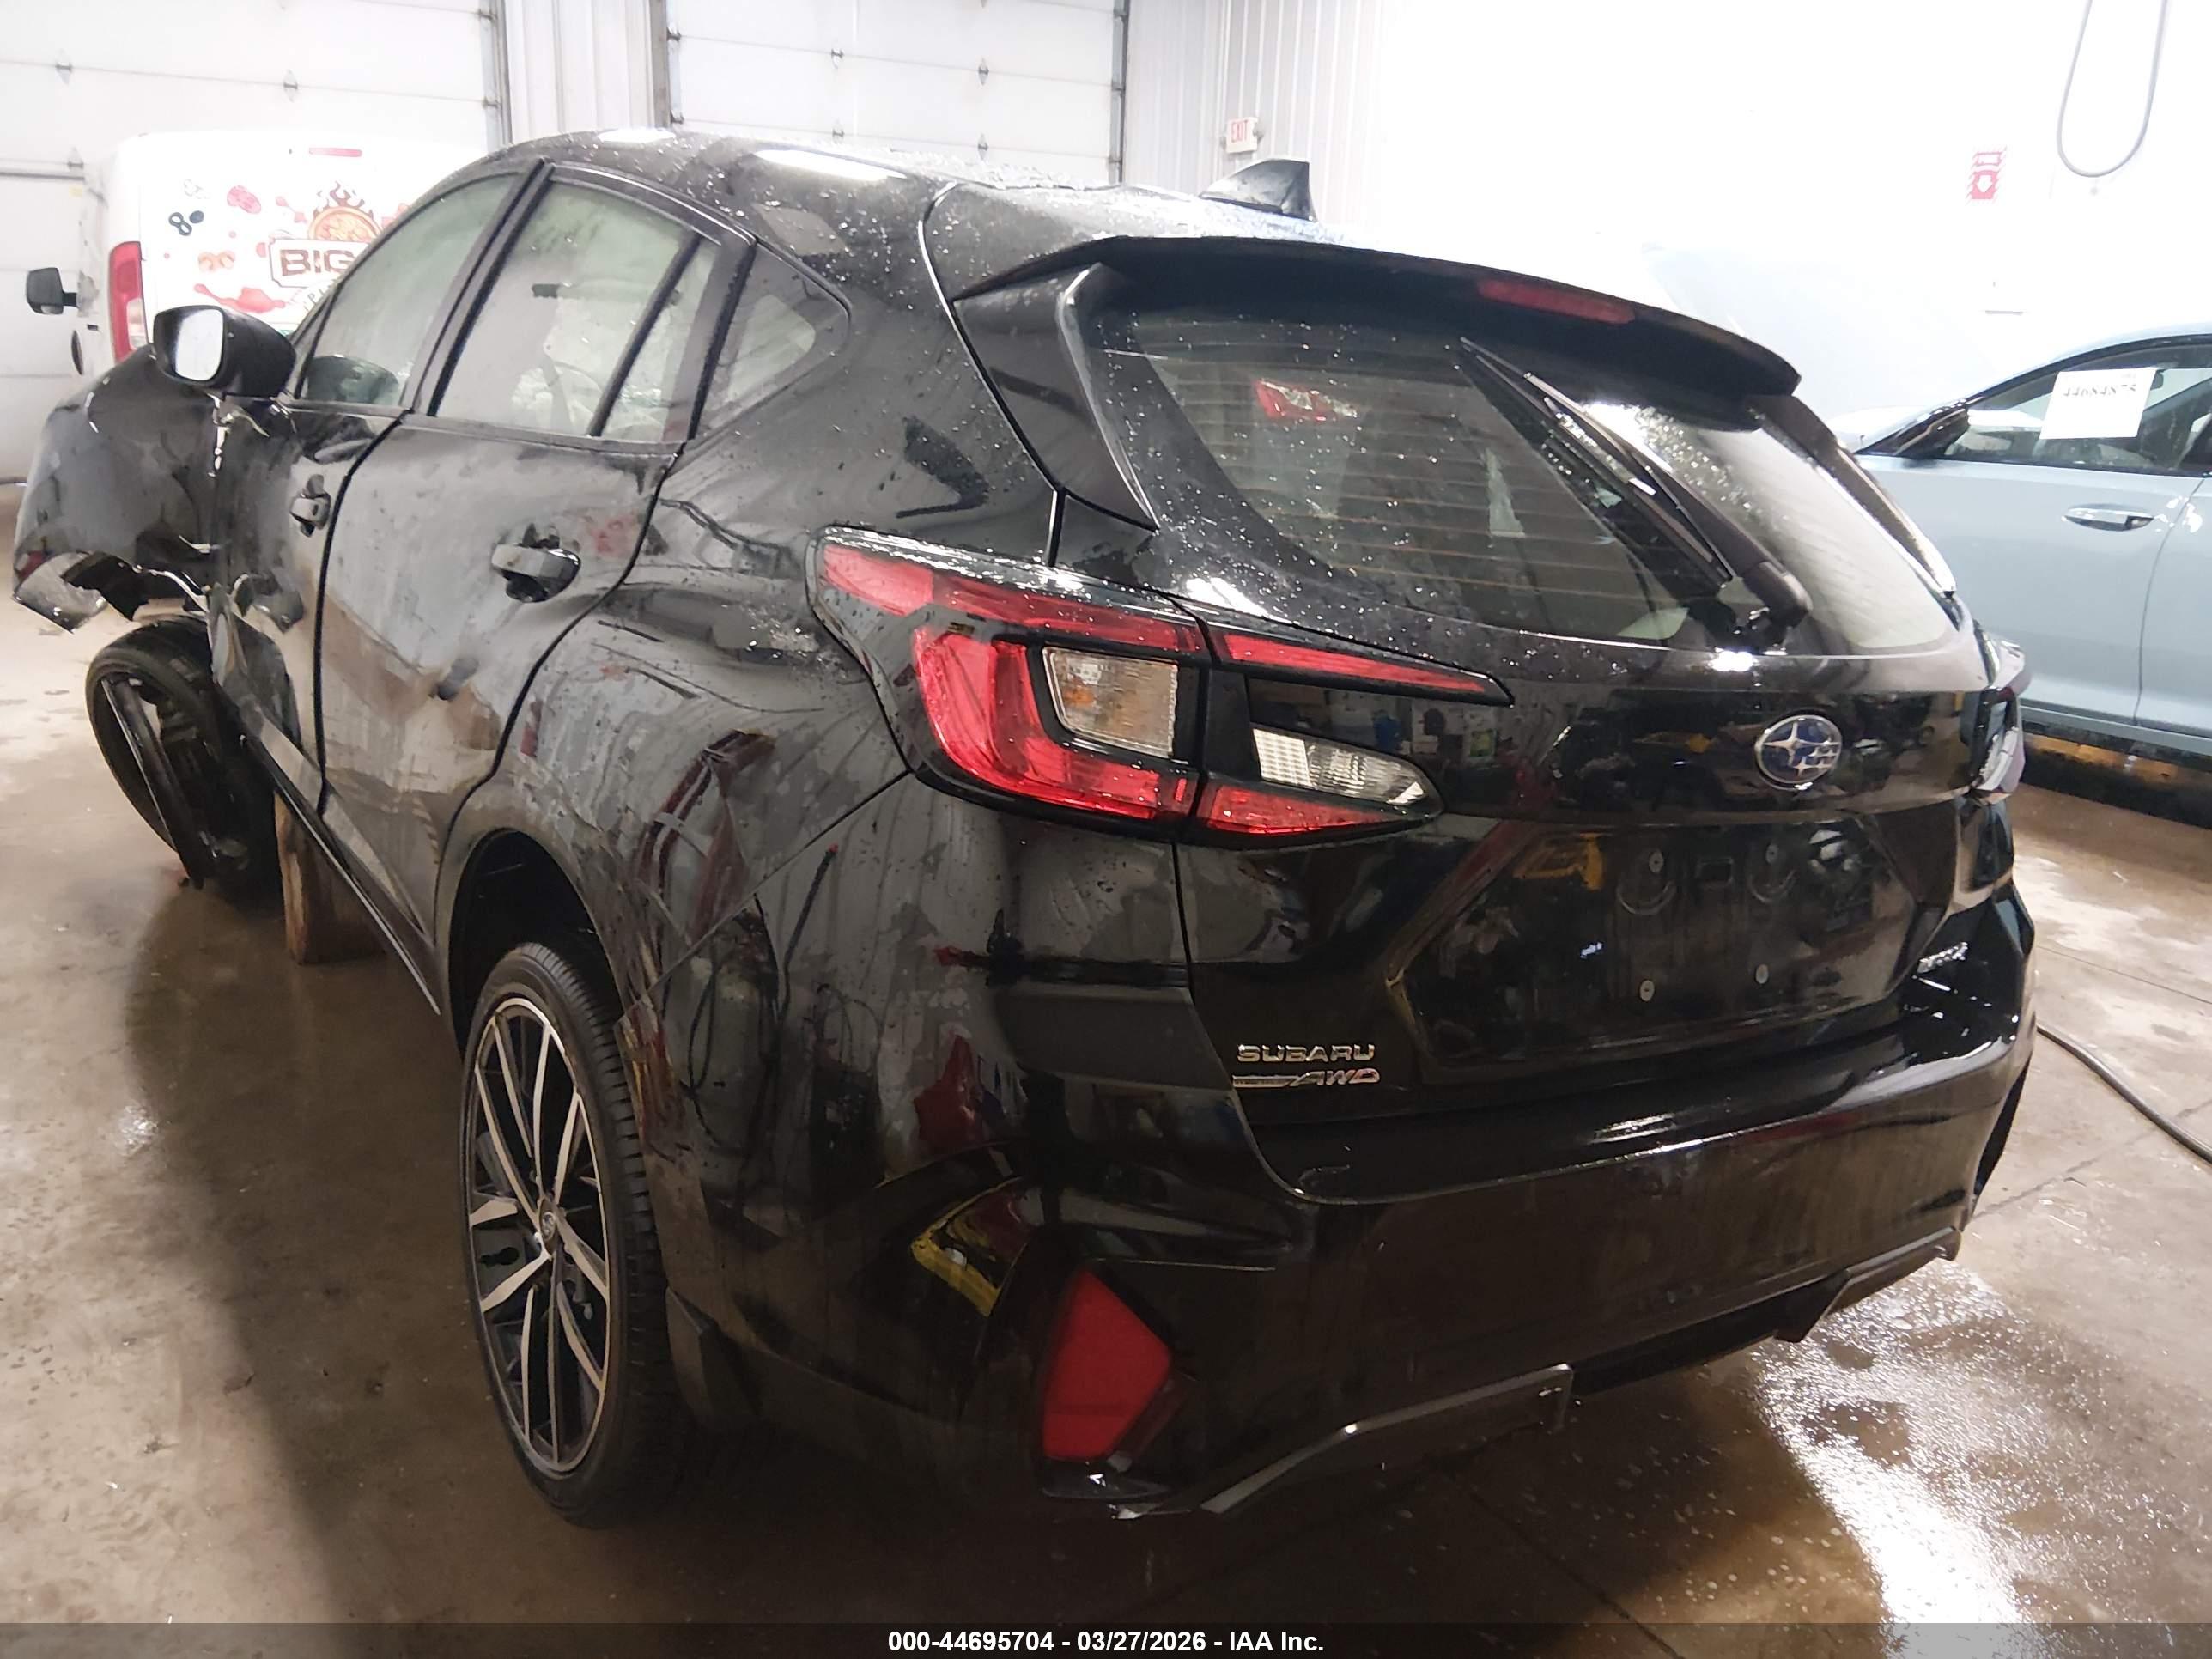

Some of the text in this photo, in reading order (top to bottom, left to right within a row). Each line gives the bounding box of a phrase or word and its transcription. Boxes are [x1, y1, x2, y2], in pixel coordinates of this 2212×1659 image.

[1231, 119, 1249, 143] EXIT
[280, 249, 356, 276] BIG
[1237, 1044, 1375, 1062] SUBARU
[1289, 1068, 1380, 1087] AWD
